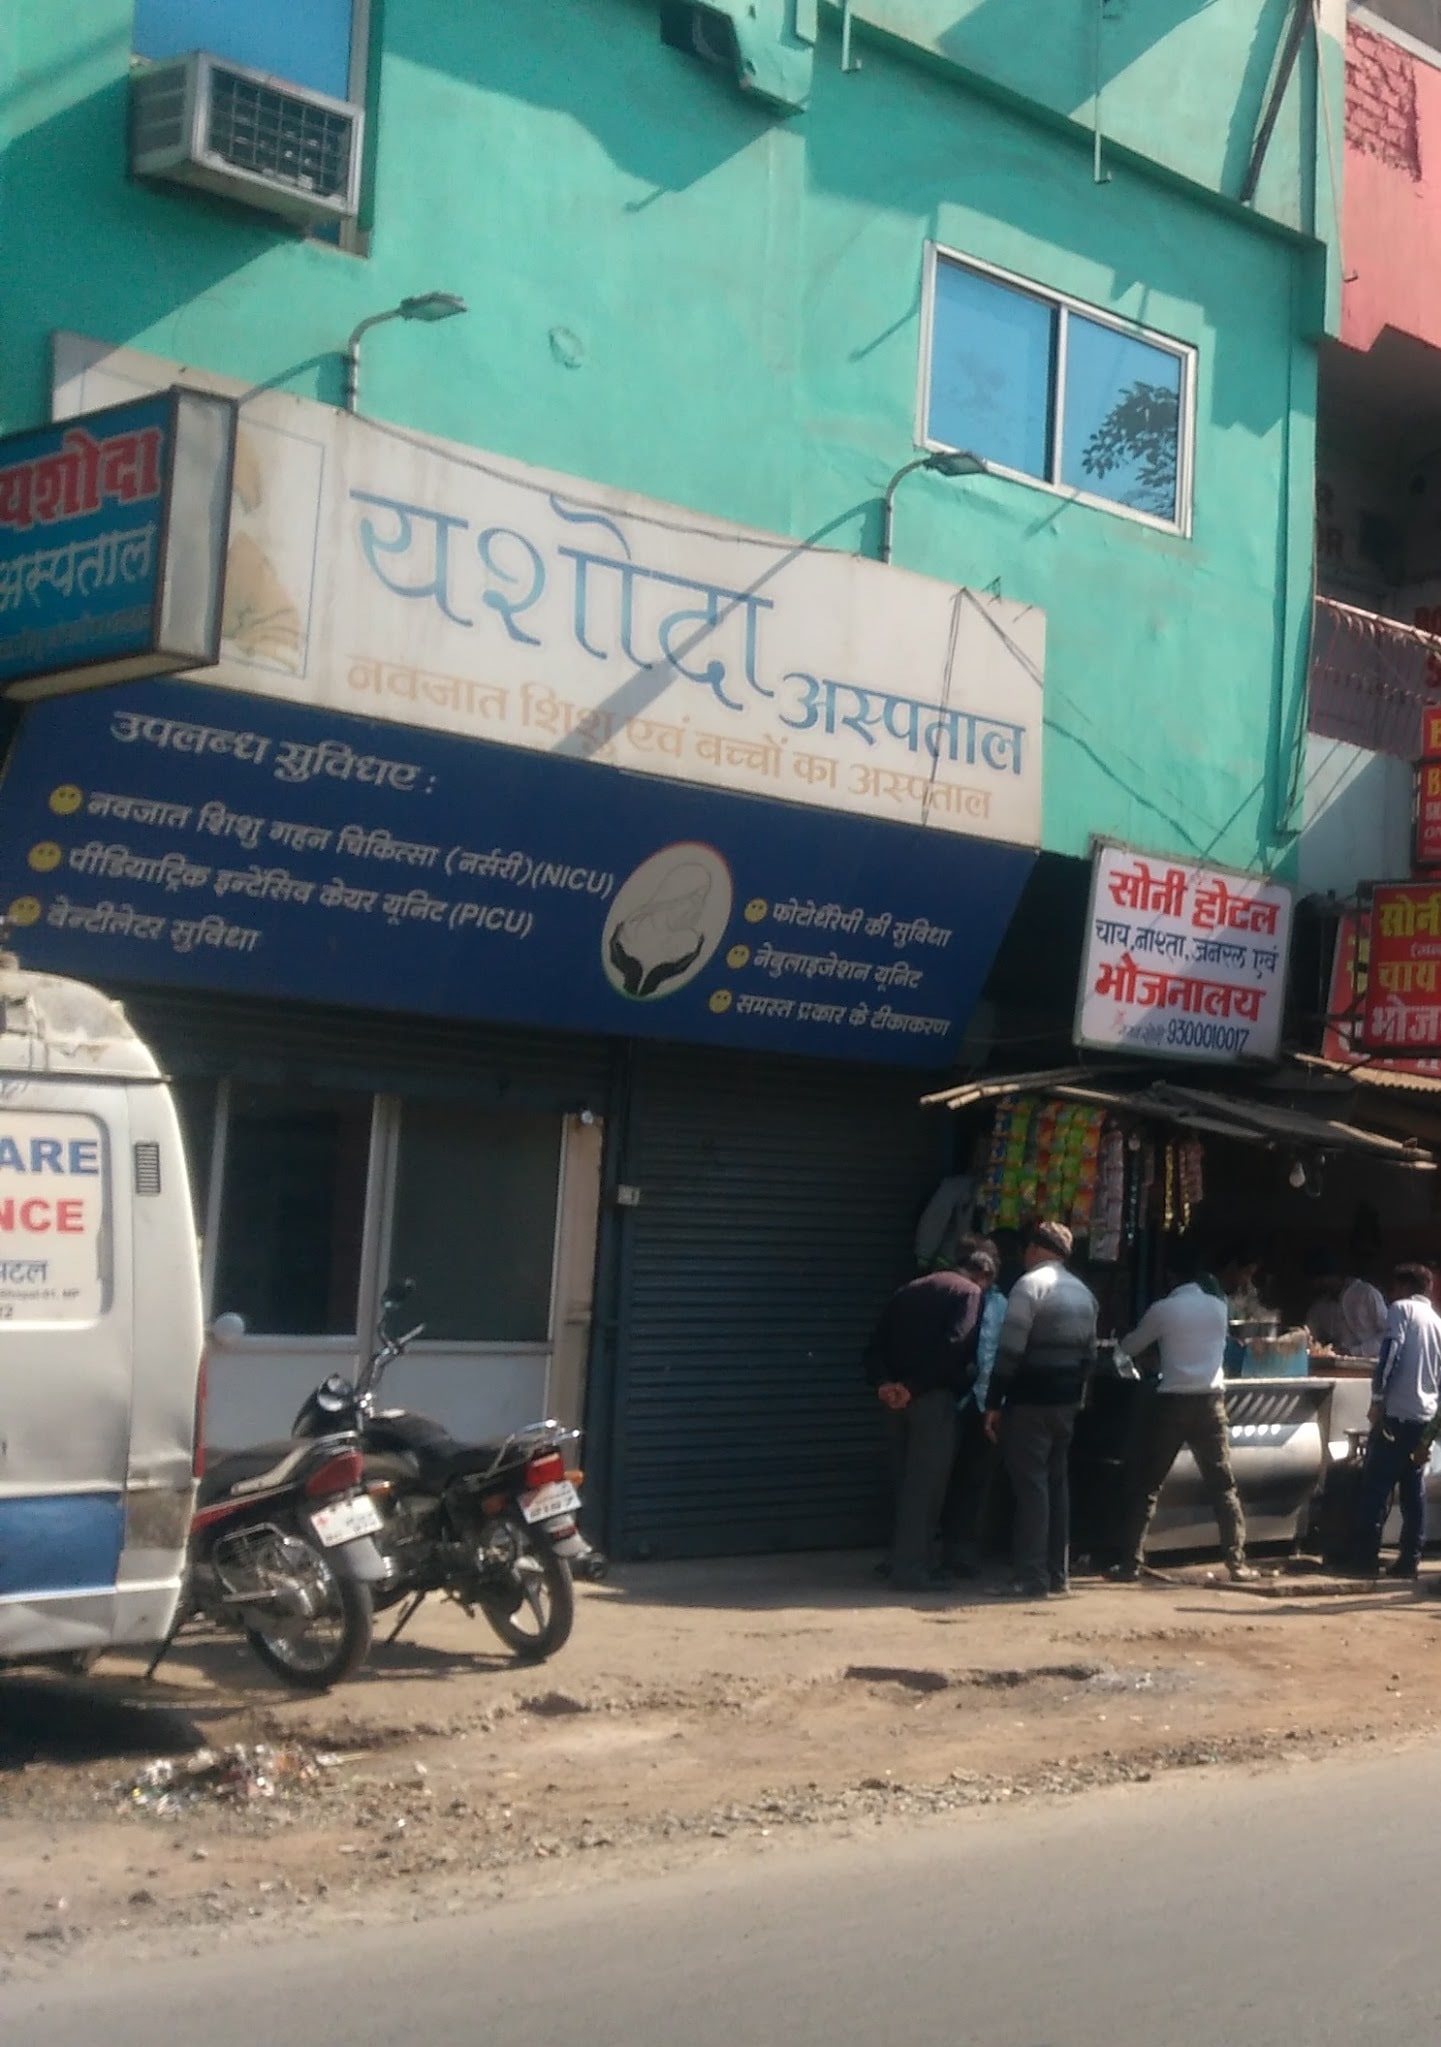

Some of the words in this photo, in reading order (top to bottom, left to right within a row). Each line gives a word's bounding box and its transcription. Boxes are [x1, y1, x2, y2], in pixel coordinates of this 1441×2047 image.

[0, 428, 162, 529] यशोदा
[350, 491, 774, 711] यशोदा
[109, 710, 272, 764] उपलब्ध
[346, 654, 509, 720] नवजात
[520, 681, 616, 760] शिशु
[626, 714, 691, 758] एवं
[794, 752, 837, 788] का
[849, 761, 992, 820] अस्पताल
[779, 671, 1025, 775] अस्पताल
[87, 791, 193, 828] नवजात
[196, 801, 266, 849] शिशु
[268, 821, 333, 851] गहन
[336, 823, 442, 868] चिकित्सा
[319, 877, 379, 913] केयर
[382, 889, 448, 925] यूनिट
[449, 903, 534, 939] (PICU)
[864, 912, 893, 940] की
[892, 917, 953, 949] सुविधा
[1108, 861, 1188, 917] सोनी
[1191, 878, 1280, 936] होटल
[169, 914, 263, 953] सुविधा
[1252, 946, 1280, 980] एवं
[874, 961, 924, 992] यूनिट
[1094, 952, 1267, 1022] भोजनालय
[736, 994, 796, 1018] समस्त
[796, 1001, 848, 1025] प्रकार
[848, 1002, 868, 1027] के
[869, 1004, 952, 1036] टीकाकरण
